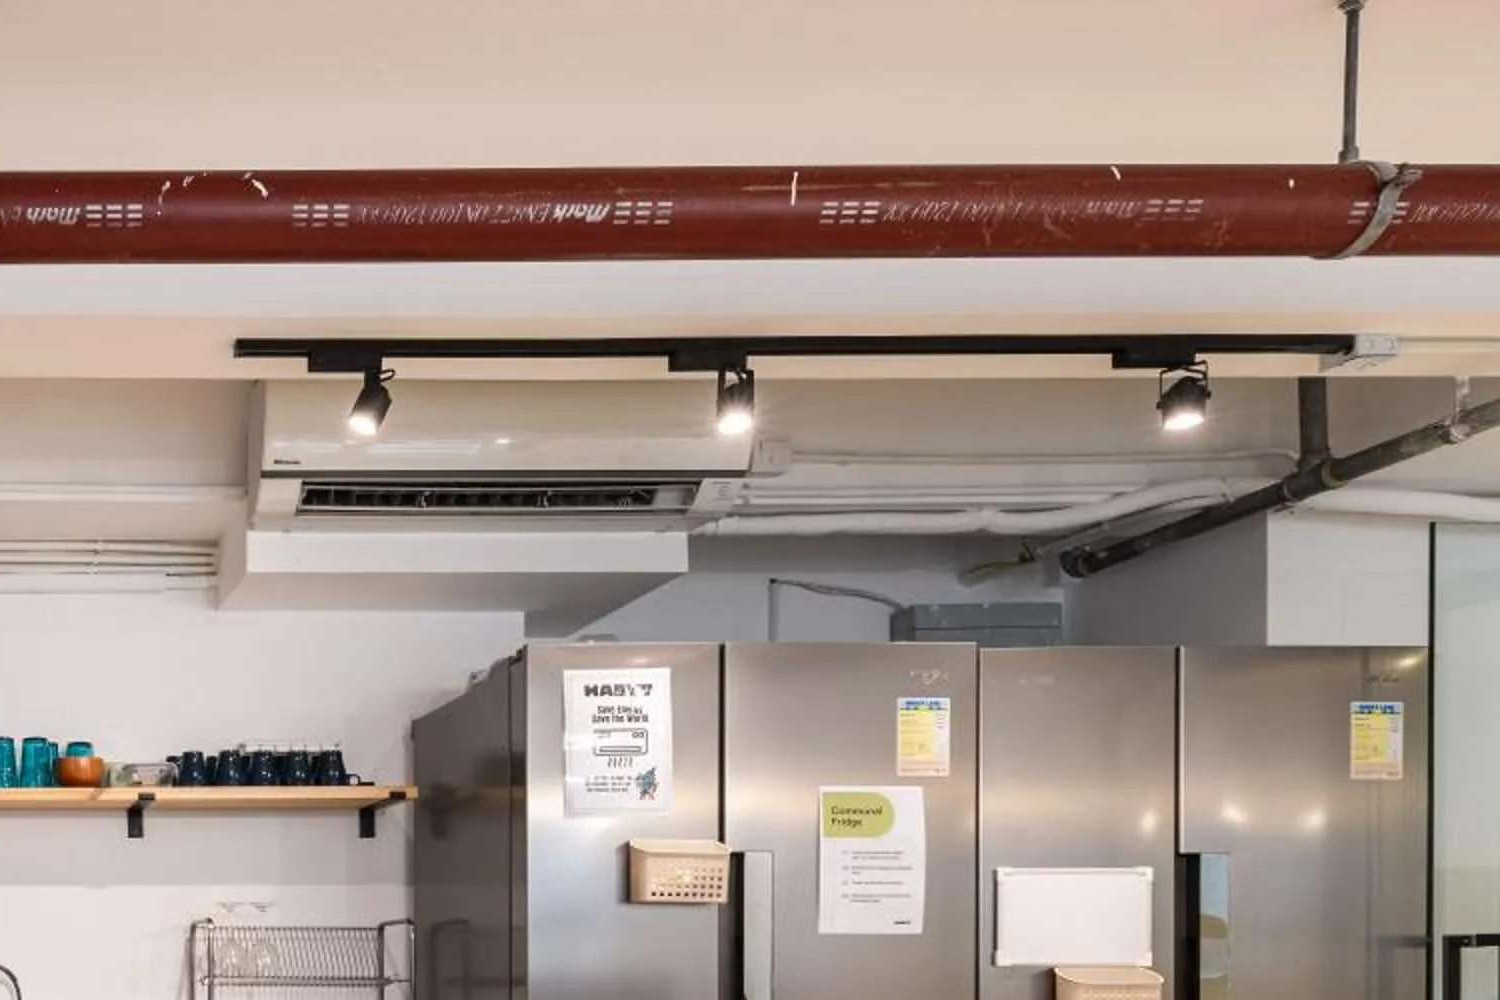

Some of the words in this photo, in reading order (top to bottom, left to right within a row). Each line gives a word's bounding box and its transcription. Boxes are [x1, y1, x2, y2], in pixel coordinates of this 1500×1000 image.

[552, 203, 611, 224] Mark
[831, 805, 883, 816] Communal
[831, 817, 863, 829] Fridge
